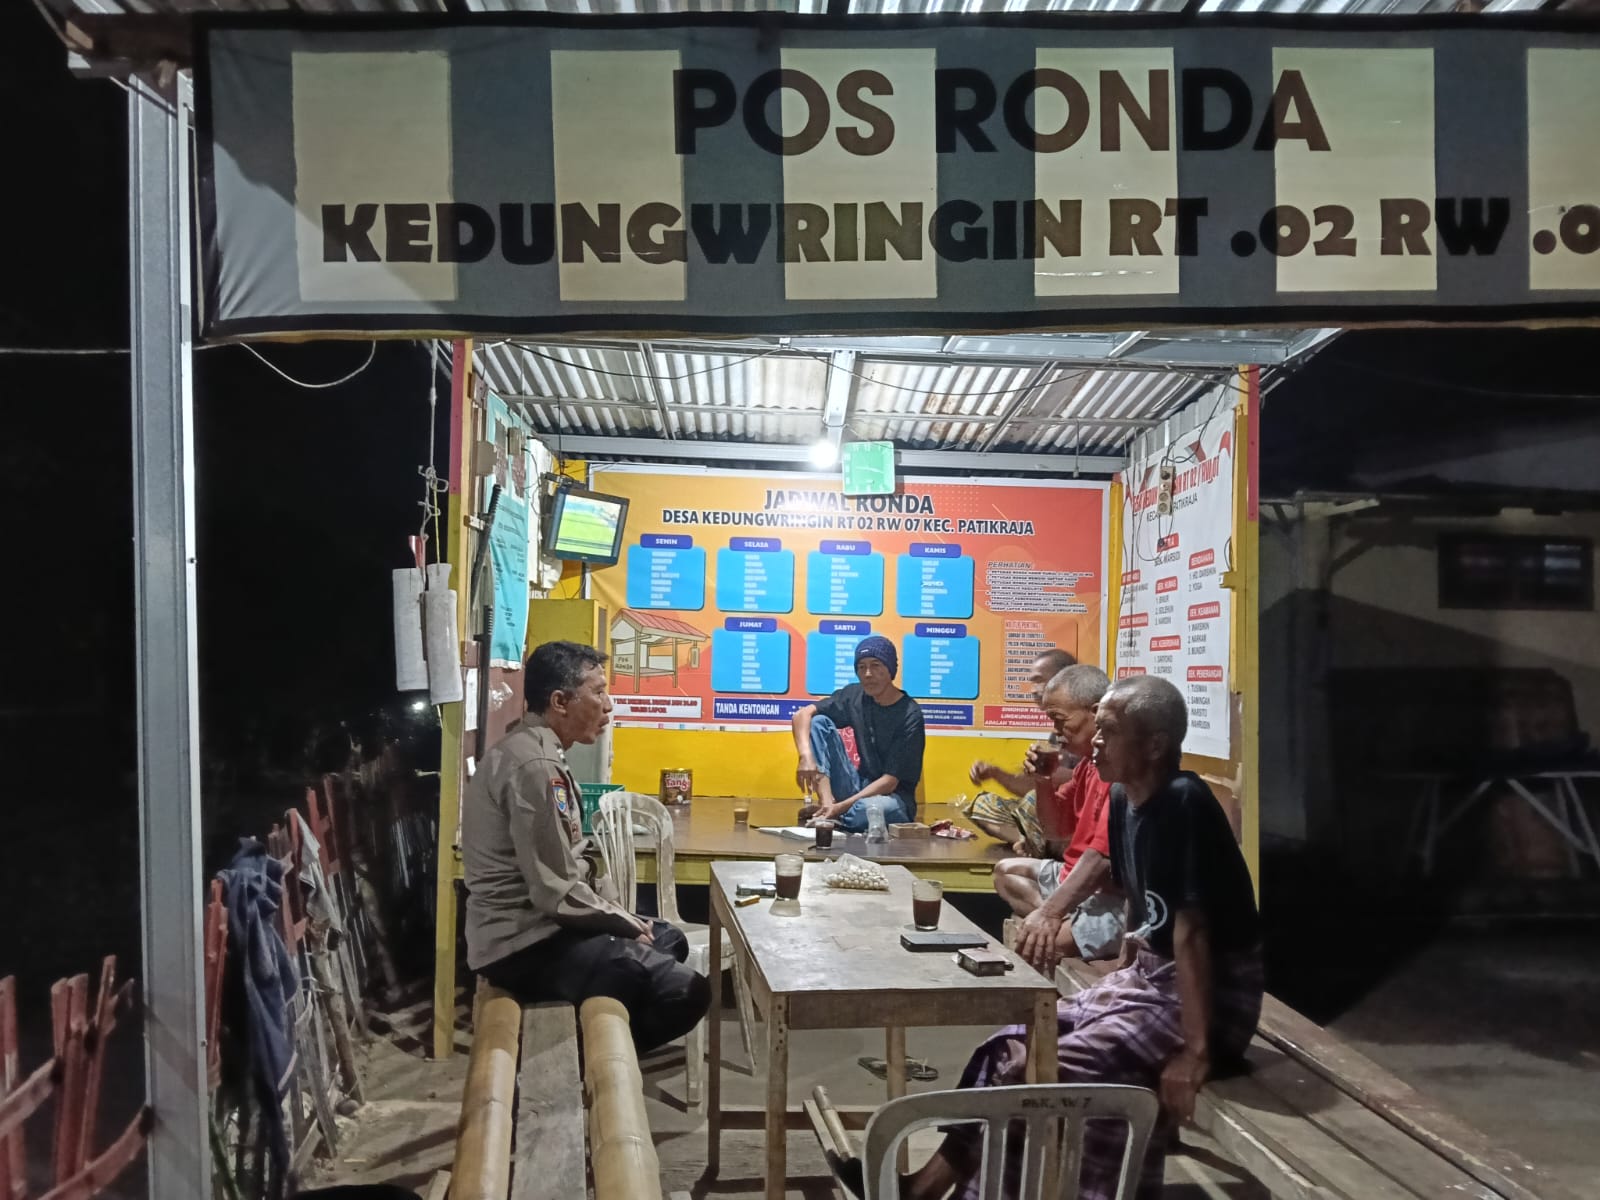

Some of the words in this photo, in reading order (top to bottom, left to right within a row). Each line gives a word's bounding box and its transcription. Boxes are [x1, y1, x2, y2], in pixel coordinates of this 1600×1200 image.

[672, 68, 895, 156] POS
[936, 67, 1331, 153] RONDA
[321, 199, 1083, 265] KEDUNGWRINGIN
[1109, 198, 1208, 256] RT
[1230, 204, 1357, 258] .02
[1380, 198, 1510, 257] RW
[764, 490, 850, 512] JADWAL
[856, 494, 935, 515] RONDA
[662, 510, 699, 524] DESA
[702, 511, 833, 529] KEDUNGWRINGIN
[837, 516, 855, 529] RT
[857, 517, 873, 530] 02
[877, 517, 901, 531] RW
[905, 518, 920, 532] 07
[923, 519, 954, 533] KEC.
[958, 519, 1034, 535] PATIKRAJA
[716, 702, 738, 714] TANDA
[738, 703, 780, 716] KENTONGAN
